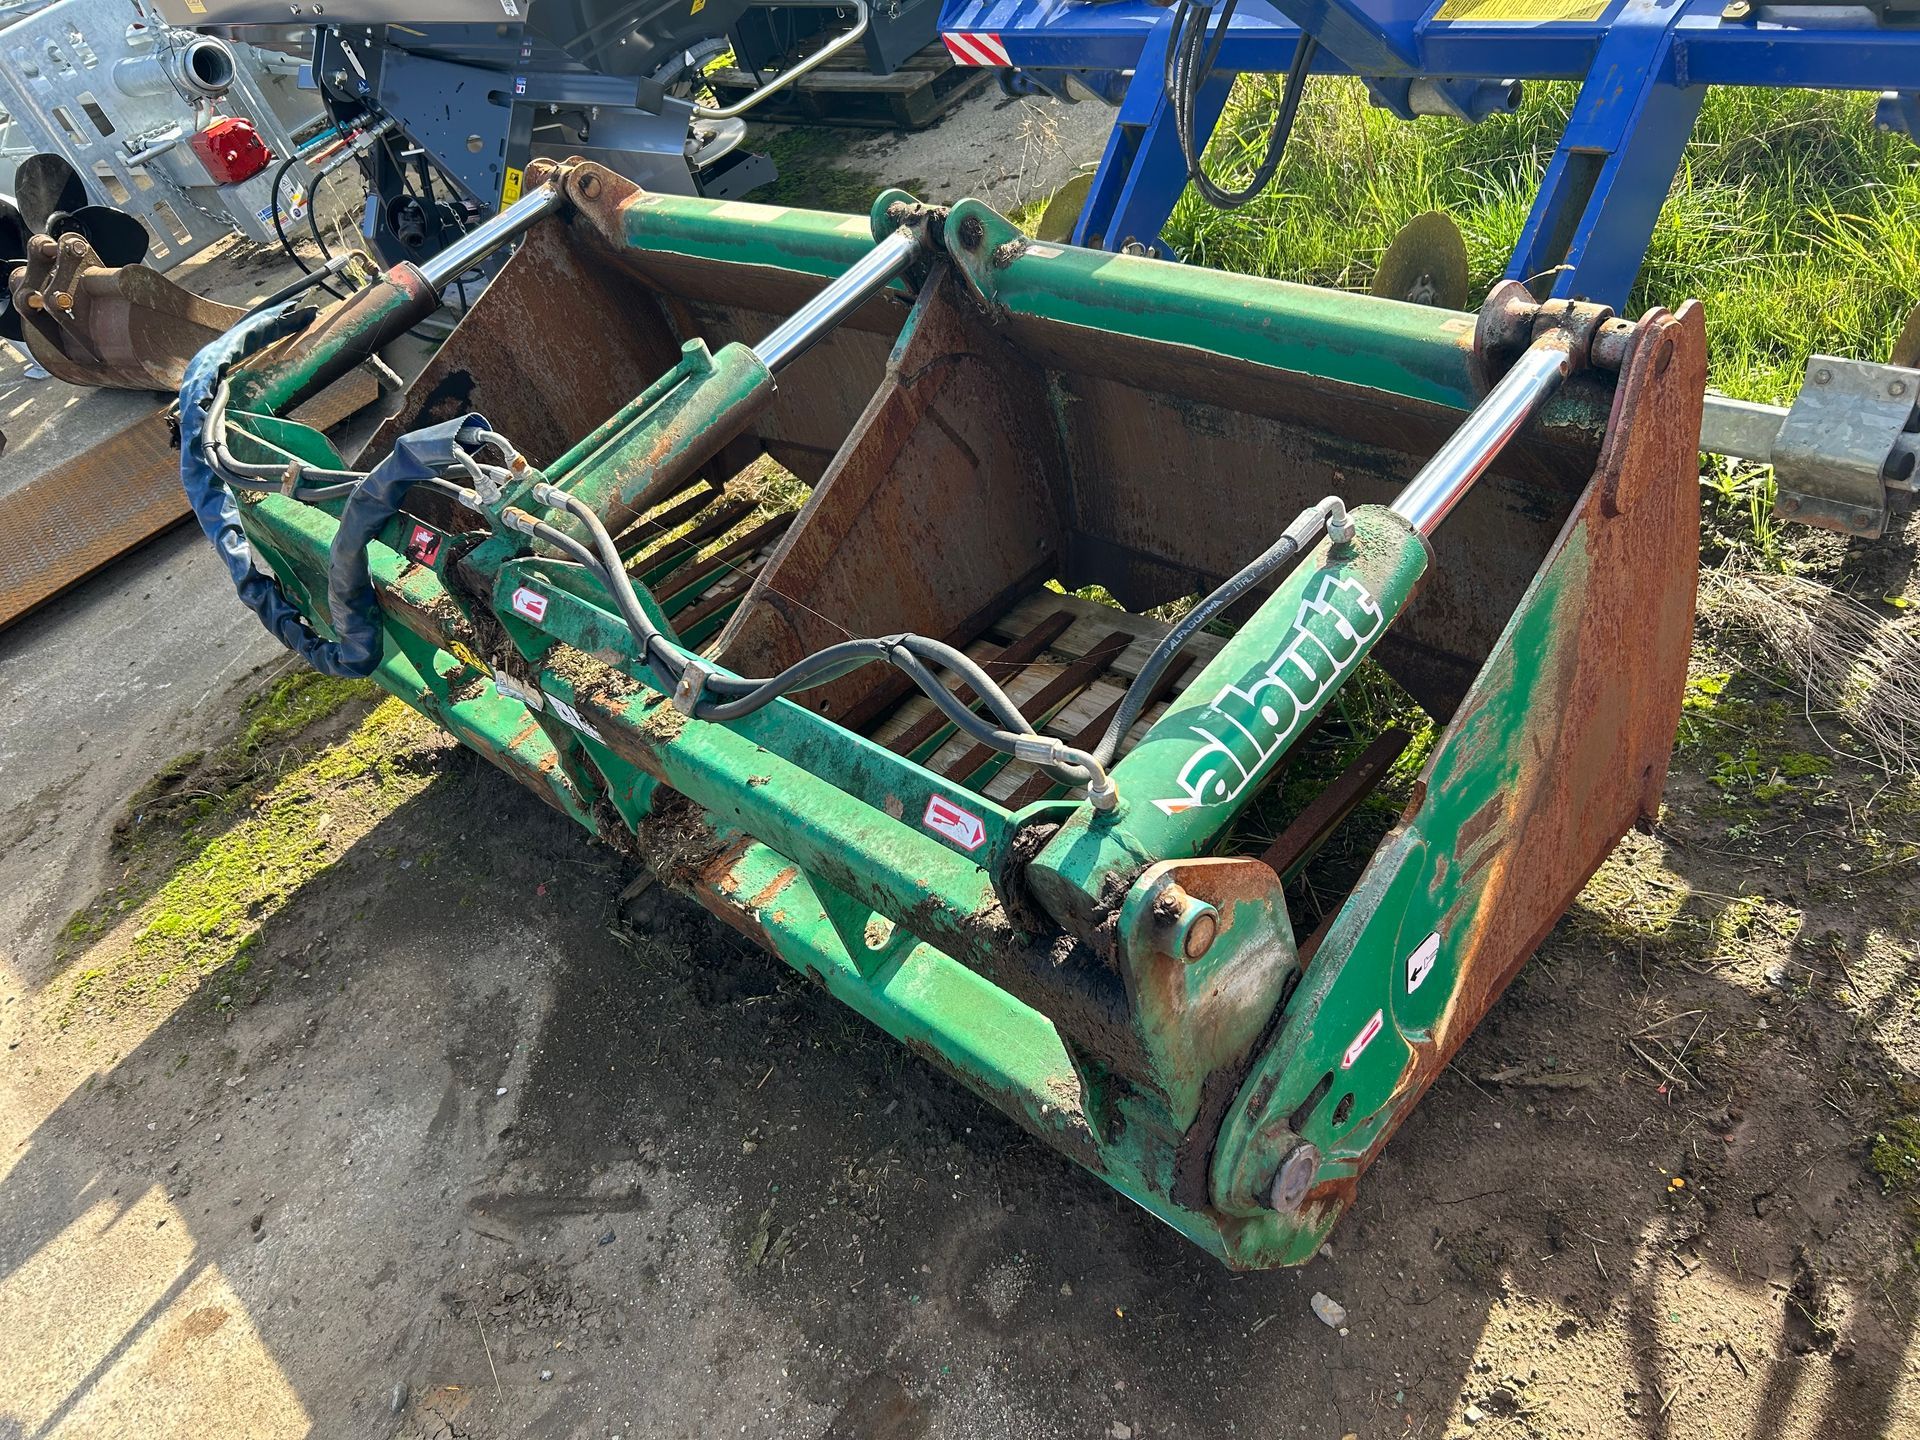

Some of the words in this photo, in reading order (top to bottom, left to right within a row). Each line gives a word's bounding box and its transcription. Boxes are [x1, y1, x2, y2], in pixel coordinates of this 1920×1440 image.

[1170, 599, 1224, 650] ALFAGOMMA
[1232, 573, 1257, 591] ITALY
[1172, 574, 1384, 808] albutt
